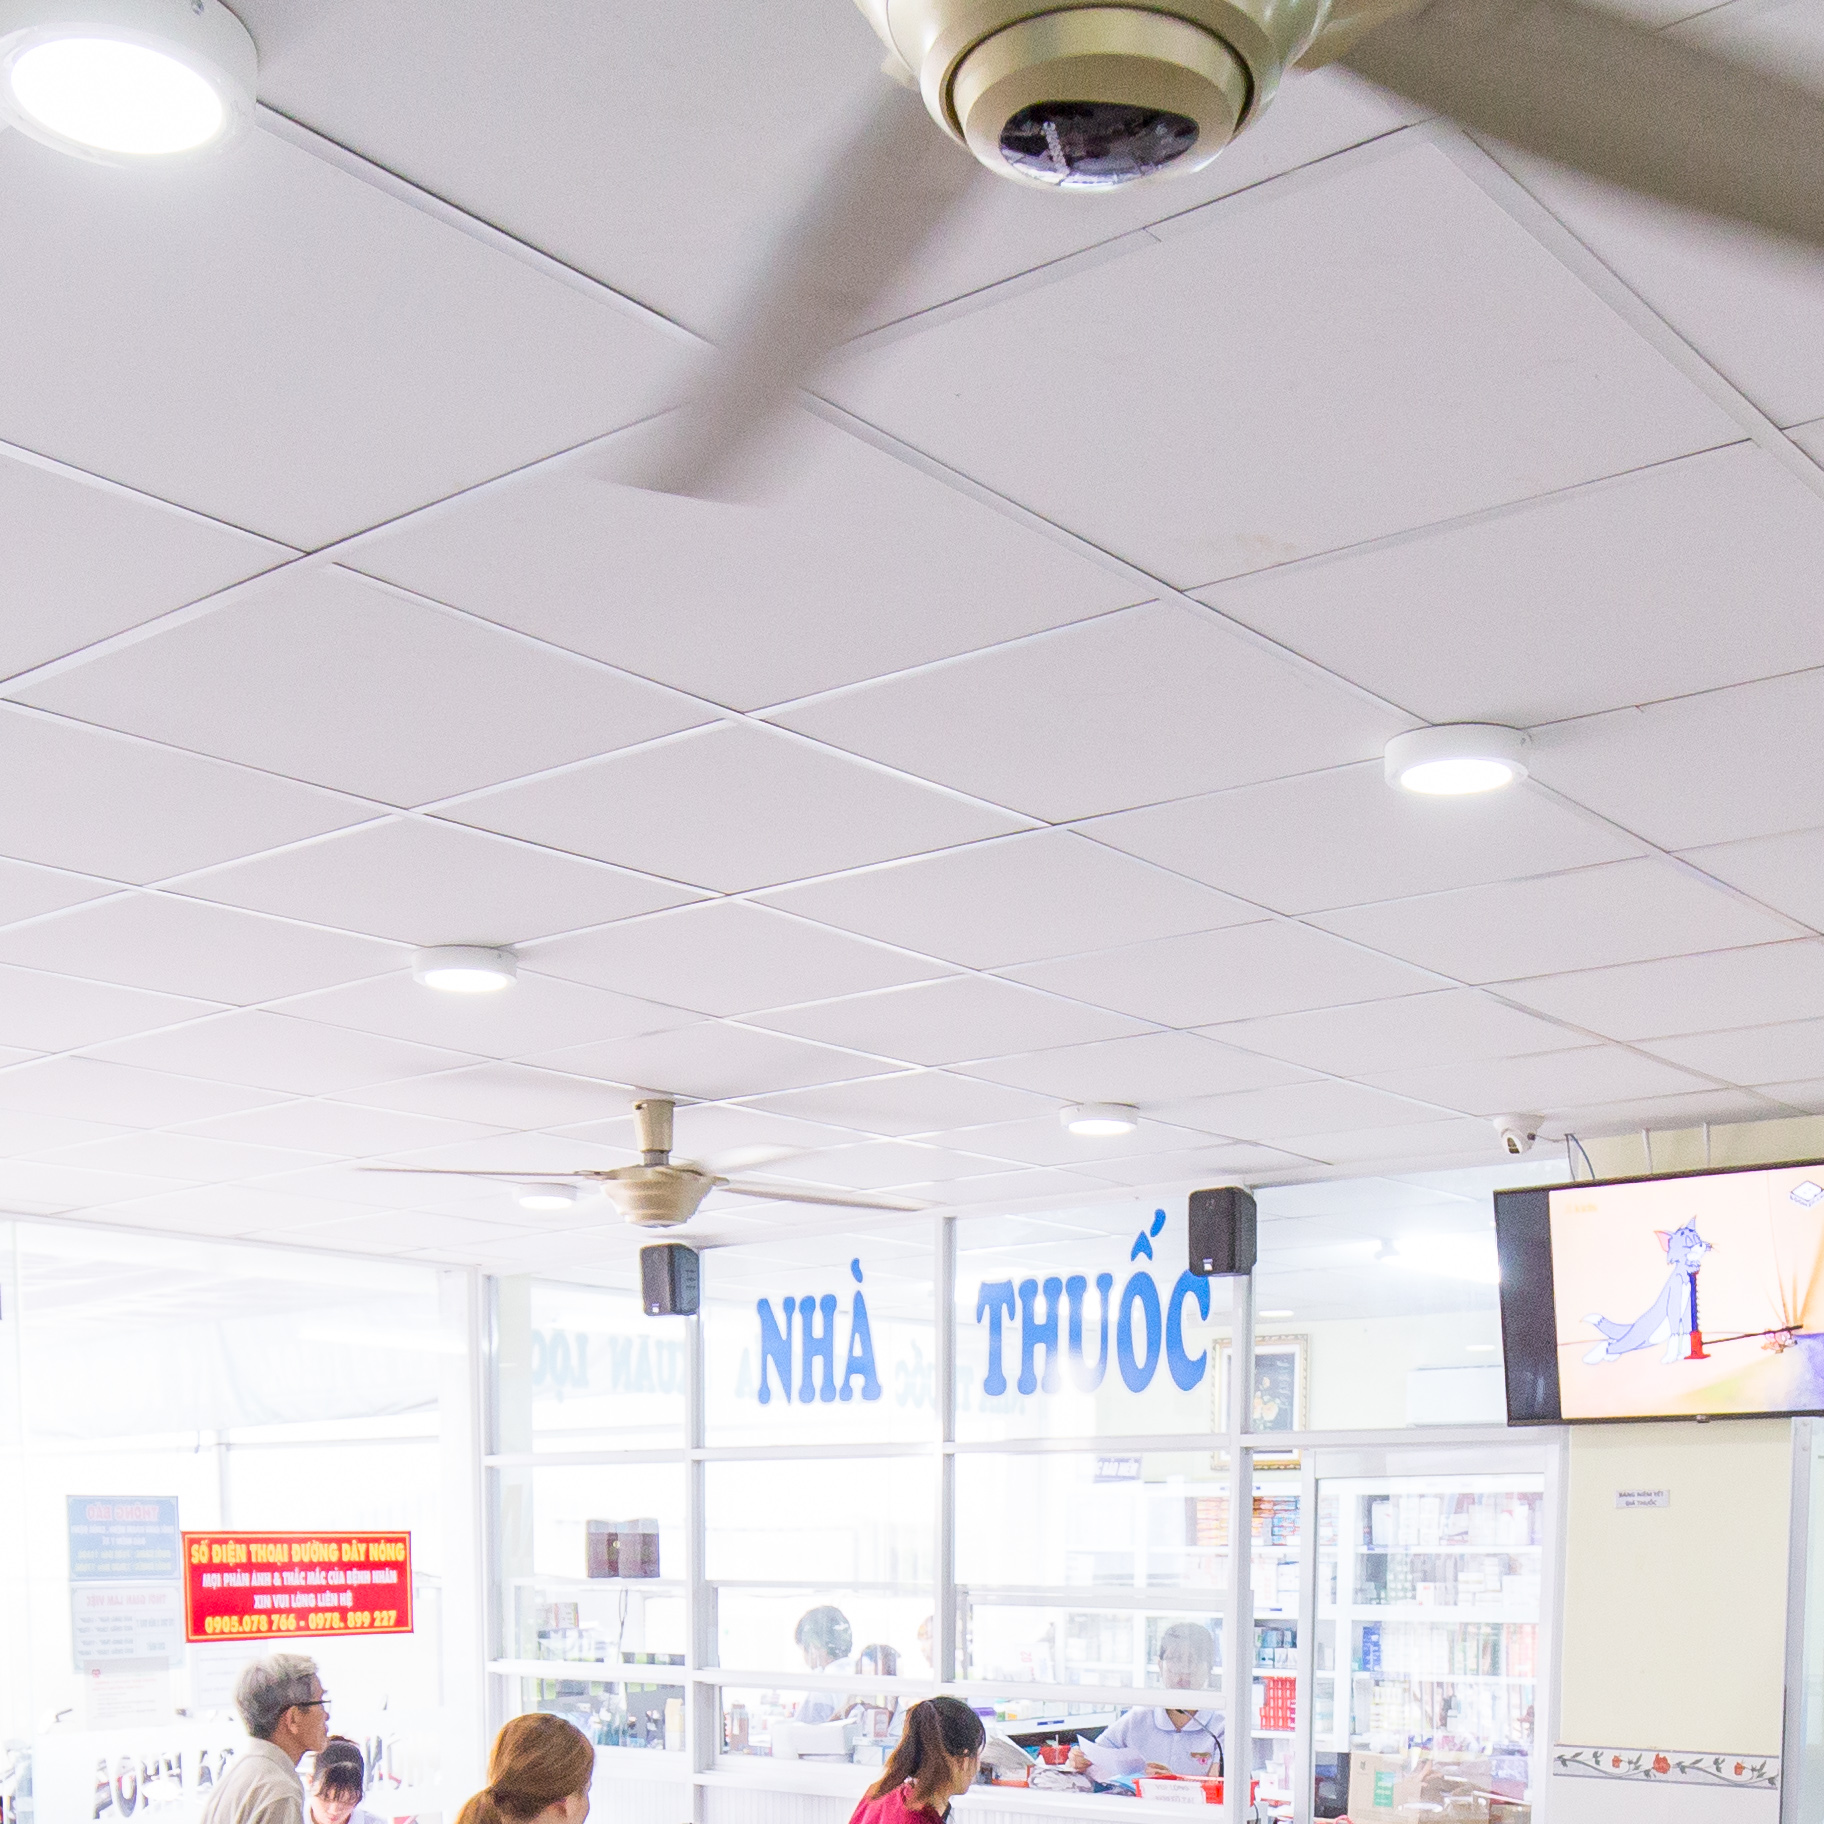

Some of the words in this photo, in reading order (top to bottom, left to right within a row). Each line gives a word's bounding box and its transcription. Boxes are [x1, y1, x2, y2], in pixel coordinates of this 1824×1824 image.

[757, 1257, 882, 1405] NHÀ
[977, 1208, 1210, 1396] THUỐC
[191, 1539, 209, 1564] SỐ
[212, 1540, 247, 1566] ĐIỆN
[250, 1543, 289, 1566] THOẠI
[291, 1540, 339, 1562] ĐƯỜNG
[342, 1540, 367, 1562] DÂY
[369, 1540, 405, 1562] NÓNG
[205, 1615, 268, 1634] 0905.078
[271, 1614, 296, 1631] 766
[308, 1613, 344, 1630] 0978.
[347, 1611, 371, 1628] 899
[373, 1610, 397, 1627] 227
